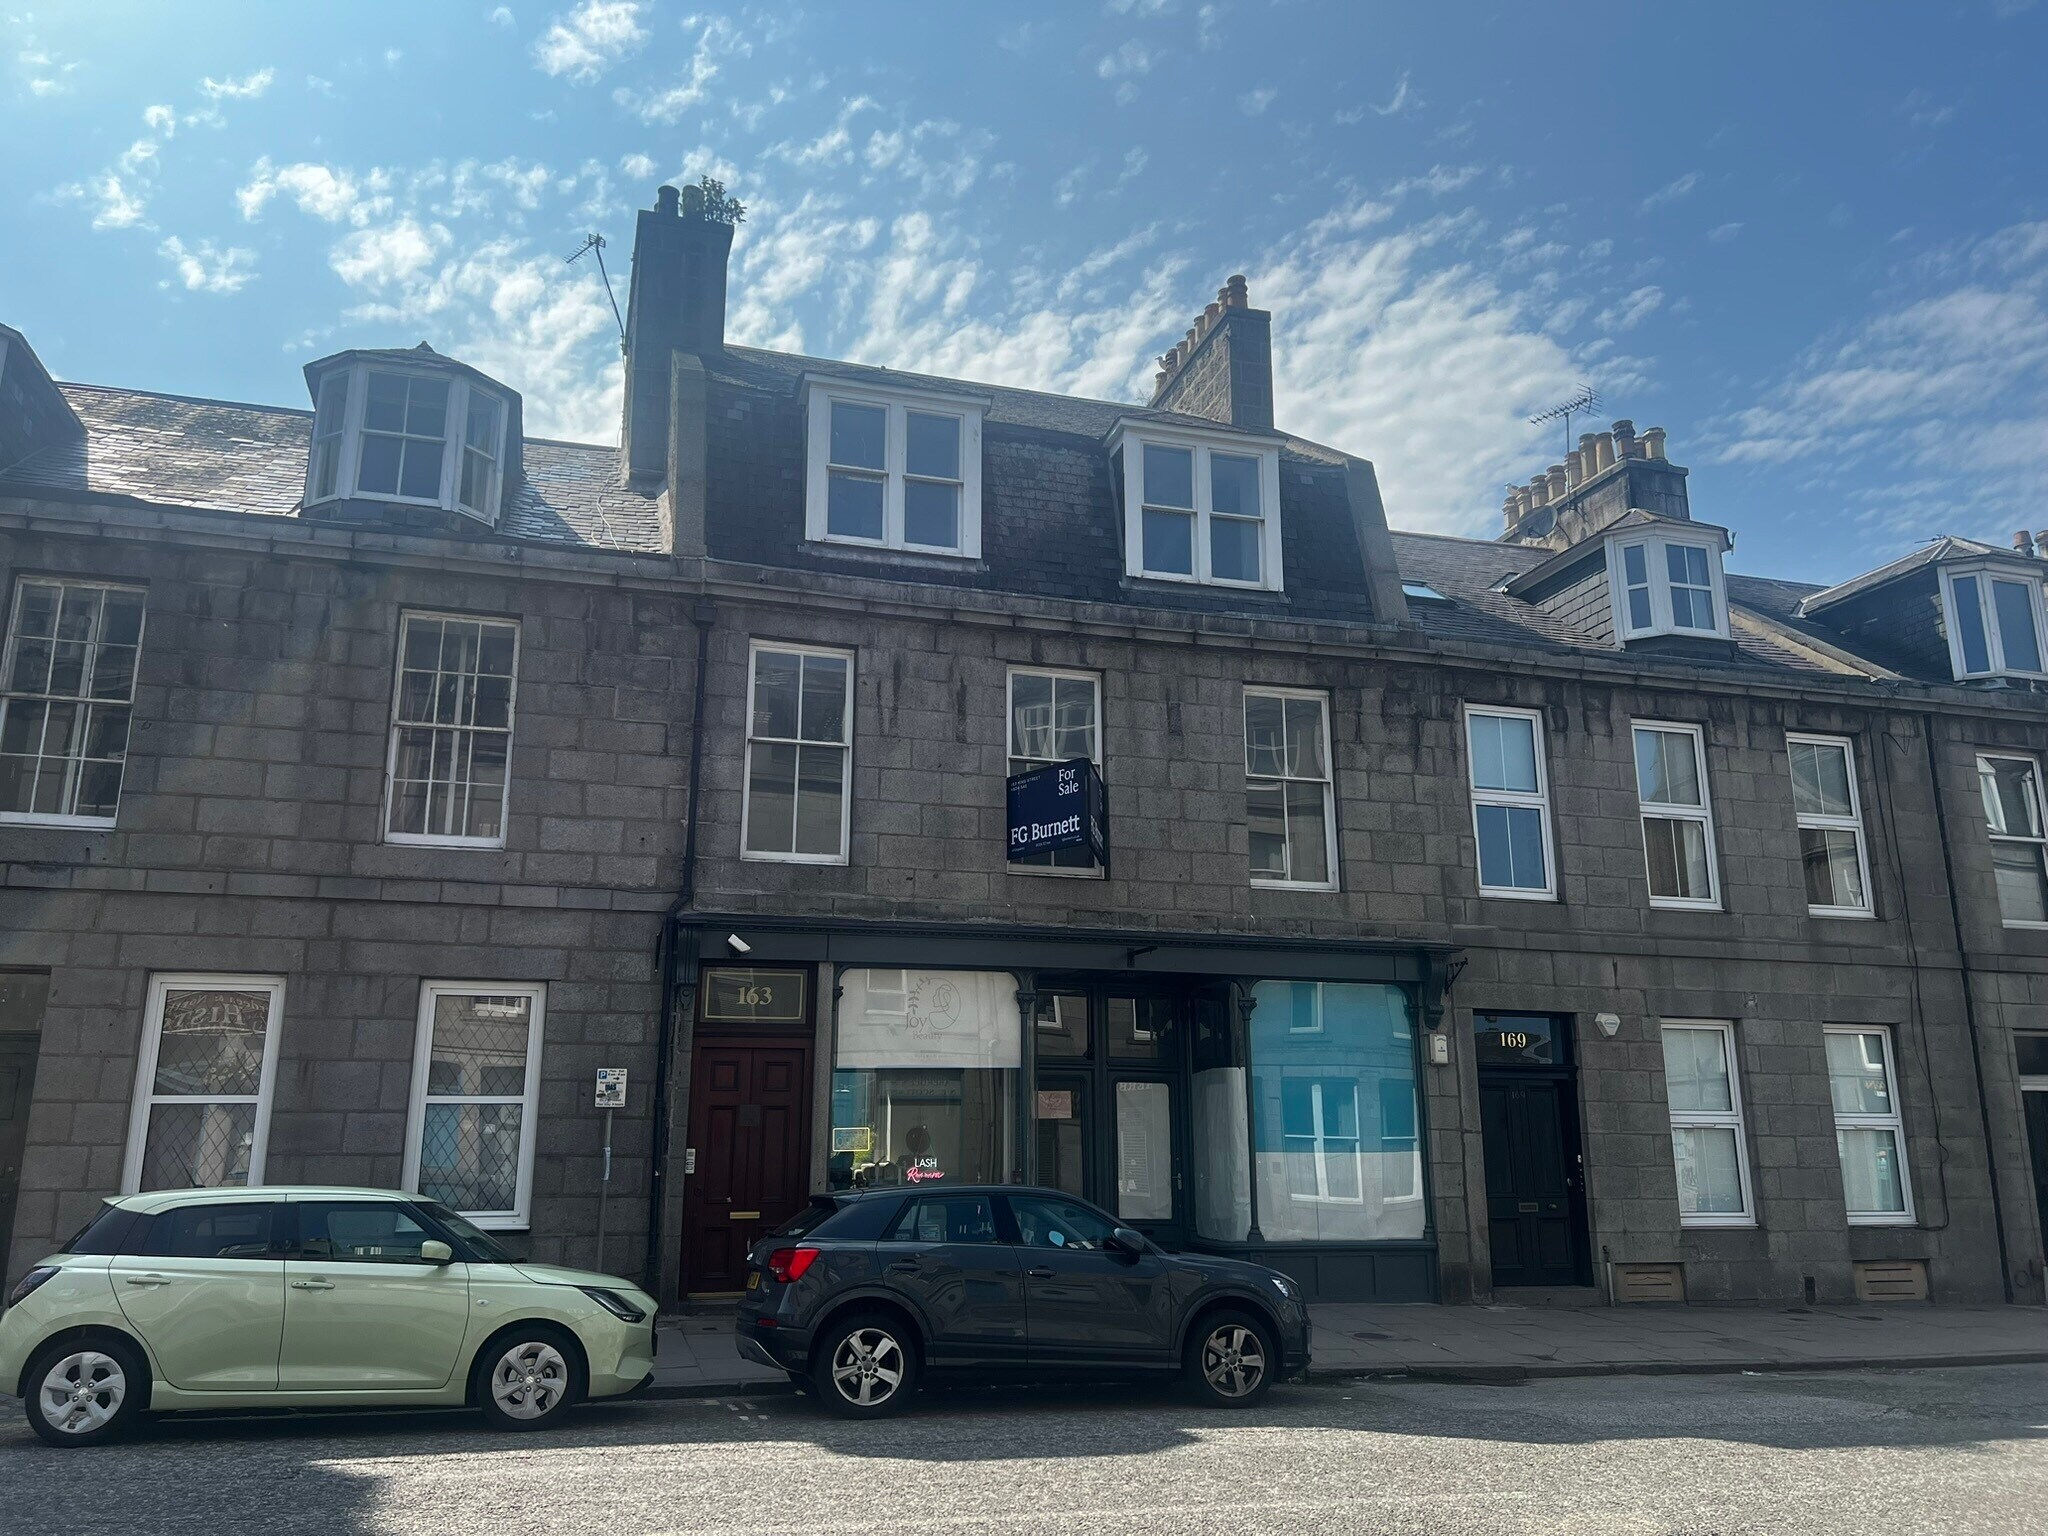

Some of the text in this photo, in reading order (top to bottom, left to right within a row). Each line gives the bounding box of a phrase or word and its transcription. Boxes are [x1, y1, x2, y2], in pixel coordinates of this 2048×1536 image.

[1058, 768, 1076, 782] For
[1058, 780, 1080, 796] Sale
[1011, 826, 1028, 845] FG
[1031, 814, 1080, 841] Burnett
[736, 986, 772, 1005] 163
[905, 1012, 928, 1032] Joy
[912, 1030, 943, 1042] Beauty
[1501, 1032, 1526, 1048] 169
[914, 1157, 938, 1168] LASH
